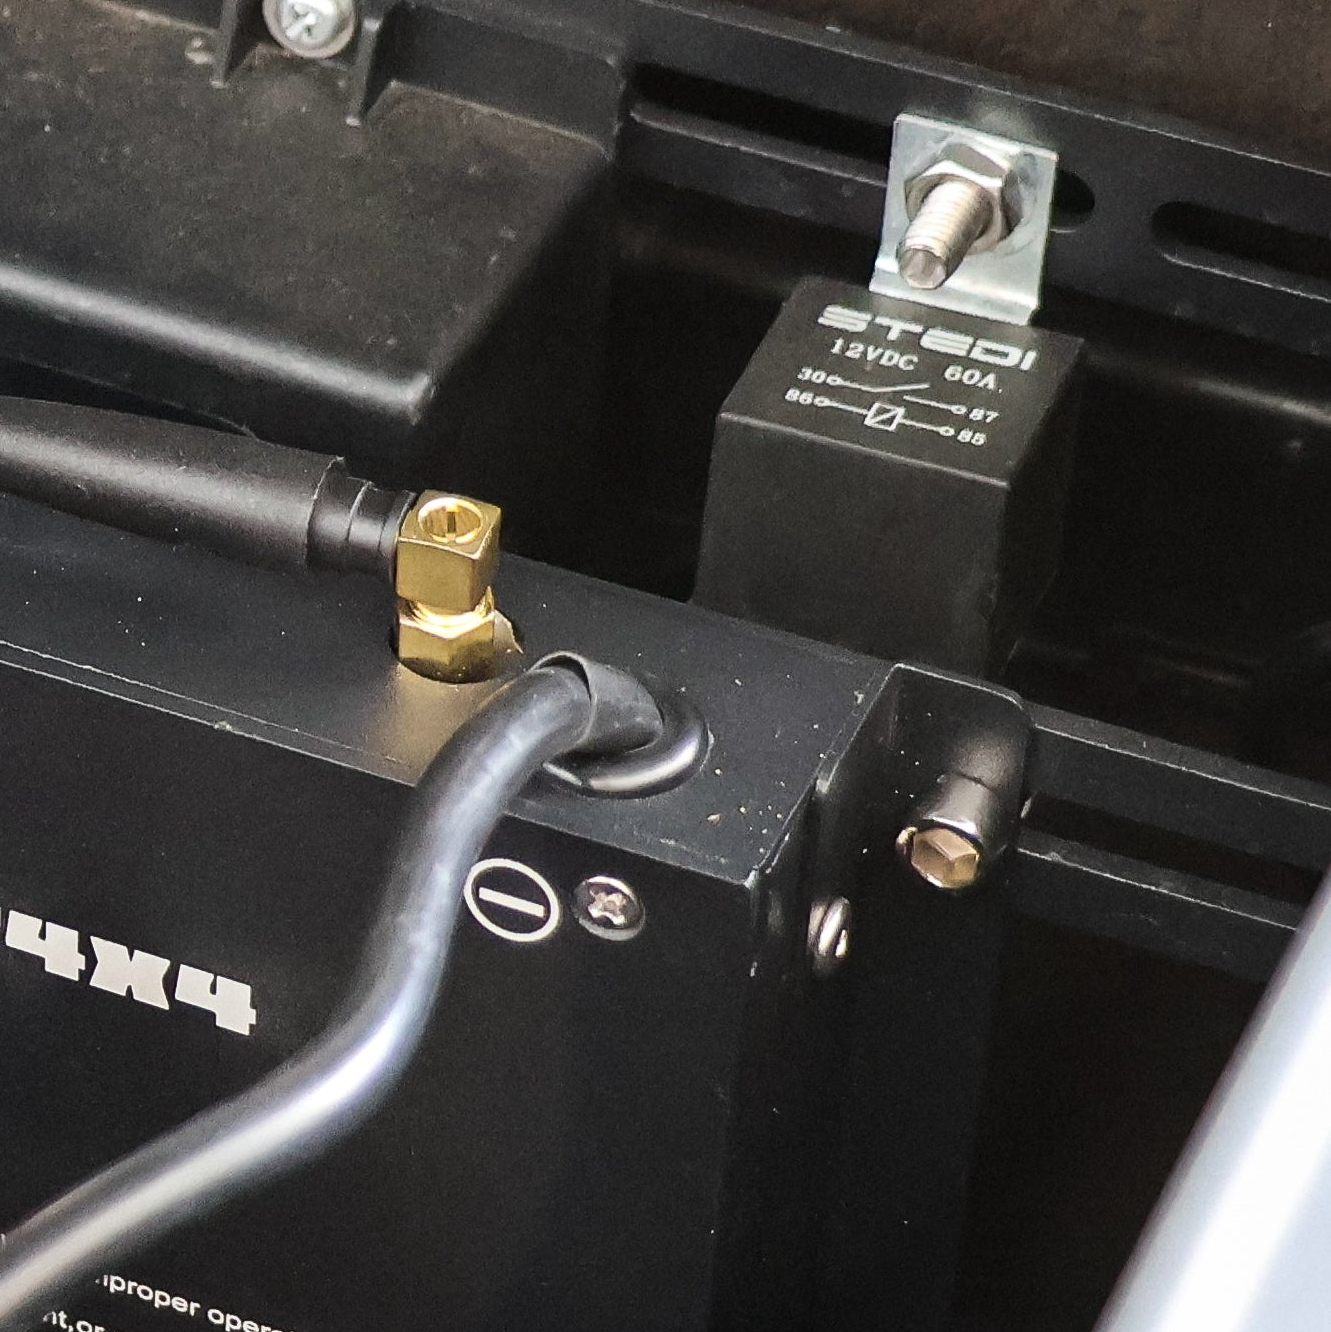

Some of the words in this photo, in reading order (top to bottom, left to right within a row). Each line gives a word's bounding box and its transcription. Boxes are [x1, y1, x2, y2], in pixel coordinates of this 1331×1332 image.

[817, 304, 1037, 371] STEDI
[829, 336, 919, 371] 12VDC
[969, 407, 1000, 424] 87
